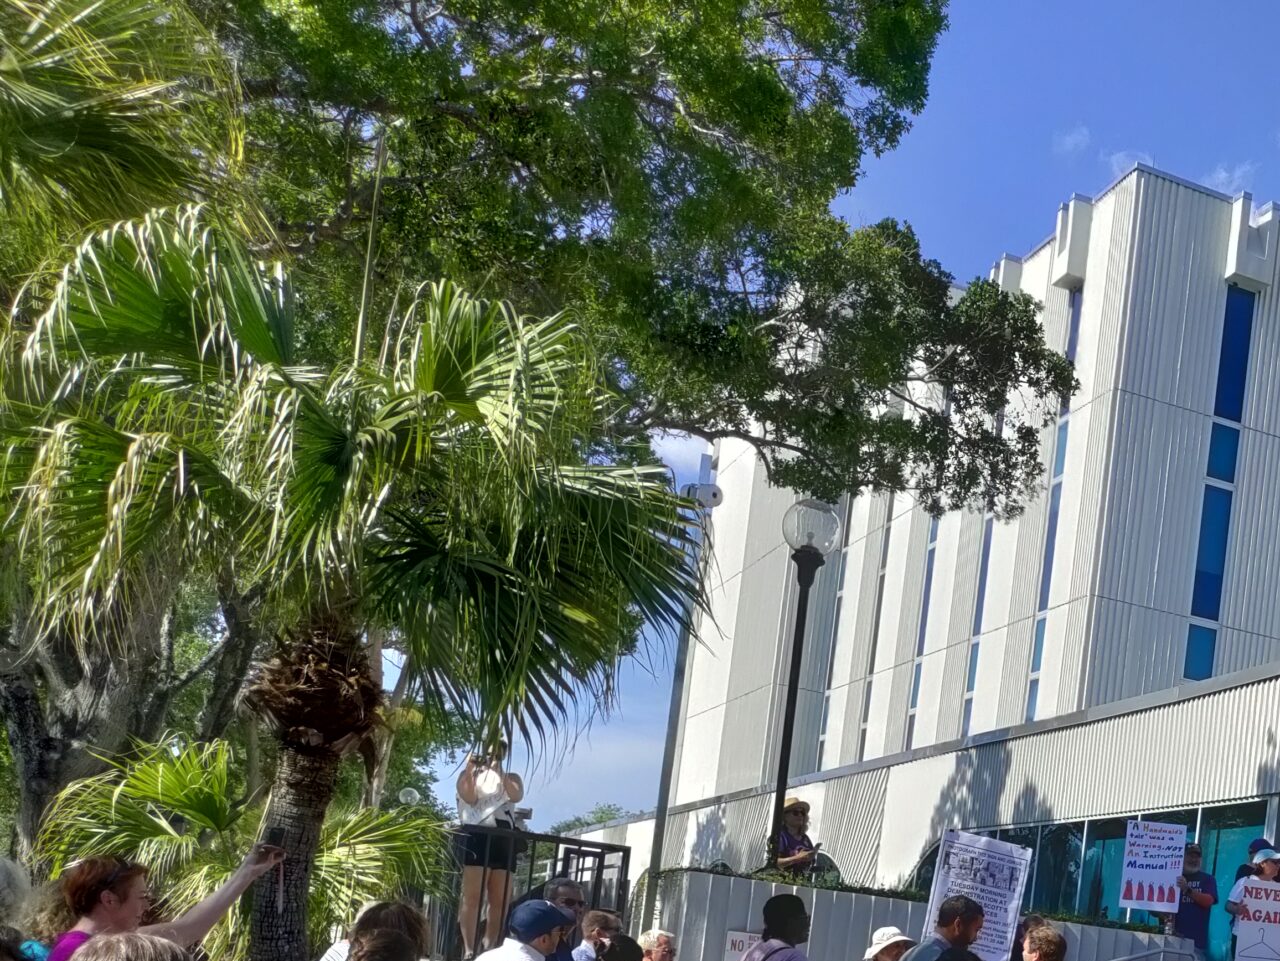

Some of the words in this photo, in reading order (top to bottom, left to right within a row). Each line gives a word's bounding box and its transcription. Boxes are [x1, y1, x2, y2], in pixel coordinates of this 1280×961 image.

[1128, 849, 1140, 857] An
[1126, 860, 1168, 870] Manual
[947, 887, 999, 904] DEMONSTRATION
[951, 880, 979, 892] TUESDAY
[980, 887, 1007, 899] MORNING
[731, 939, 744, 952] NO
